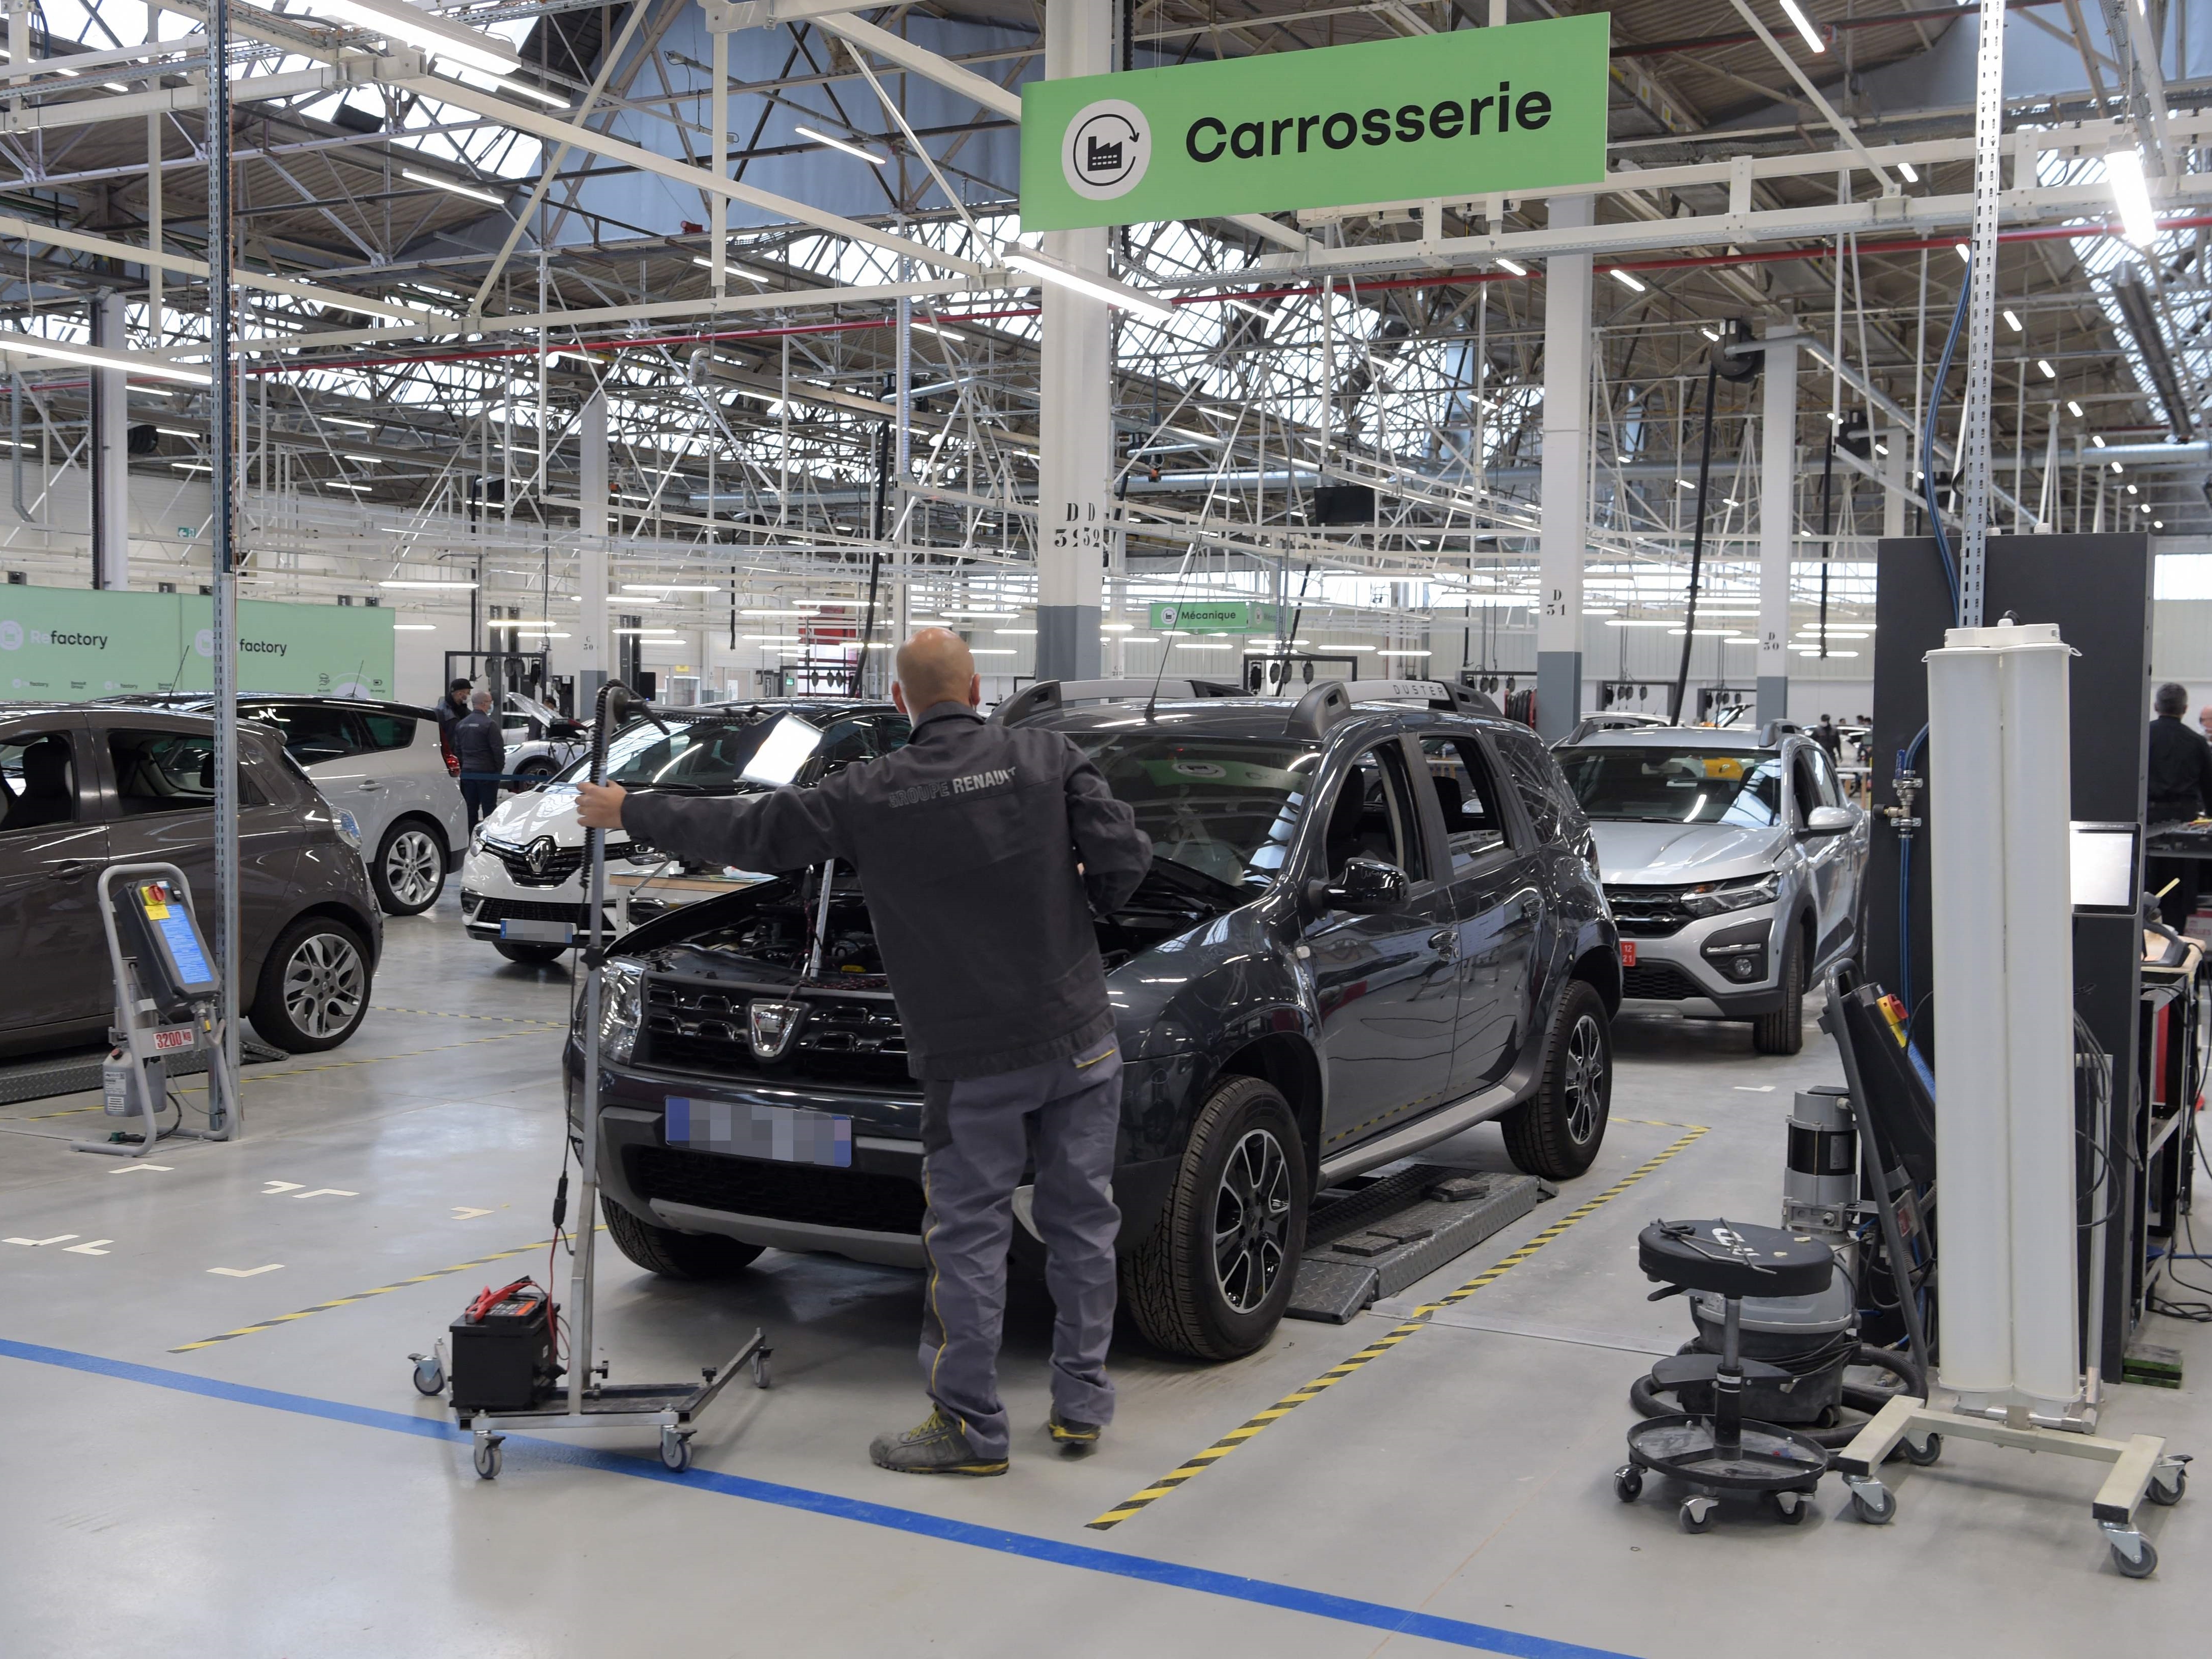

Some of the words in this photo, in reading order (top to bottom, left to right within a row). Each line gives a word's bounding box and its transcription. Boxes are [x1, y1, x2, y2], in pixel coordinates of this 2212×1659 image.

[1185, 80, 1552, 163] Carrosserie
[1088, 502, 1096, 521] D
[1553, 589, 1562, 601] D
[1181, 610, 1236, 621] Mécanique
[30, 630, 108, 649] Refactory
[1768, 632, 1775, 640] D
[236, 639, 287, 657] factory
[1393, 684, 1445, 696] DUSTER
[1625, 944, 1632, 952] 12
[1622, 954, 1632, 963] 21
[156, 1031, 183, 1049] 3200
[183, 1030, 192, 1041] kg
